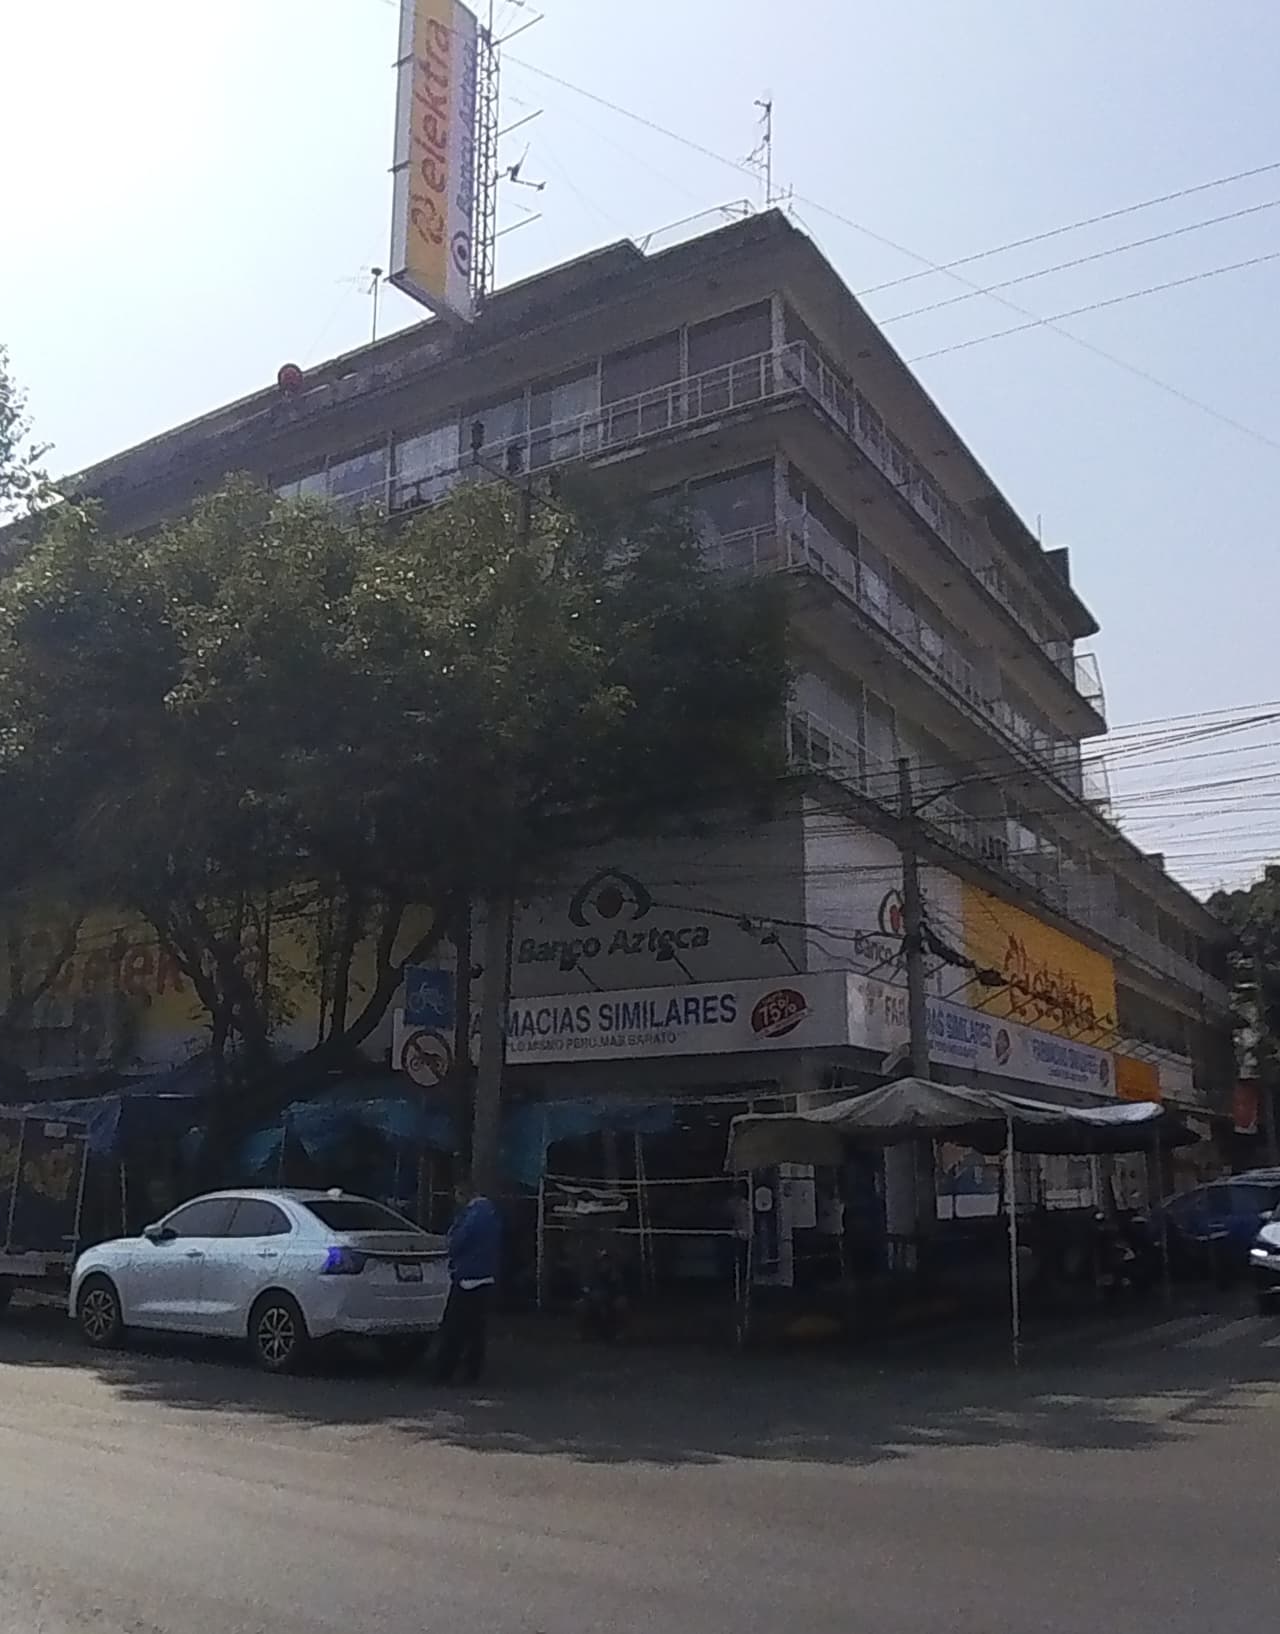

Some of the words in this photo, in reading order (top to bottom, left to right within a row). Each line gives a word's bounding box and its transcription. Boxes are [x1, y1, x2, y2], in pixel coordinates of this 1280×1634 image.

[414, 18, 451, 194] elektra
[518, 937, 601, 963] Banco
[598, 993, 737, 1032] SIMILARES
[758, 995, 797, 1025] 75%
